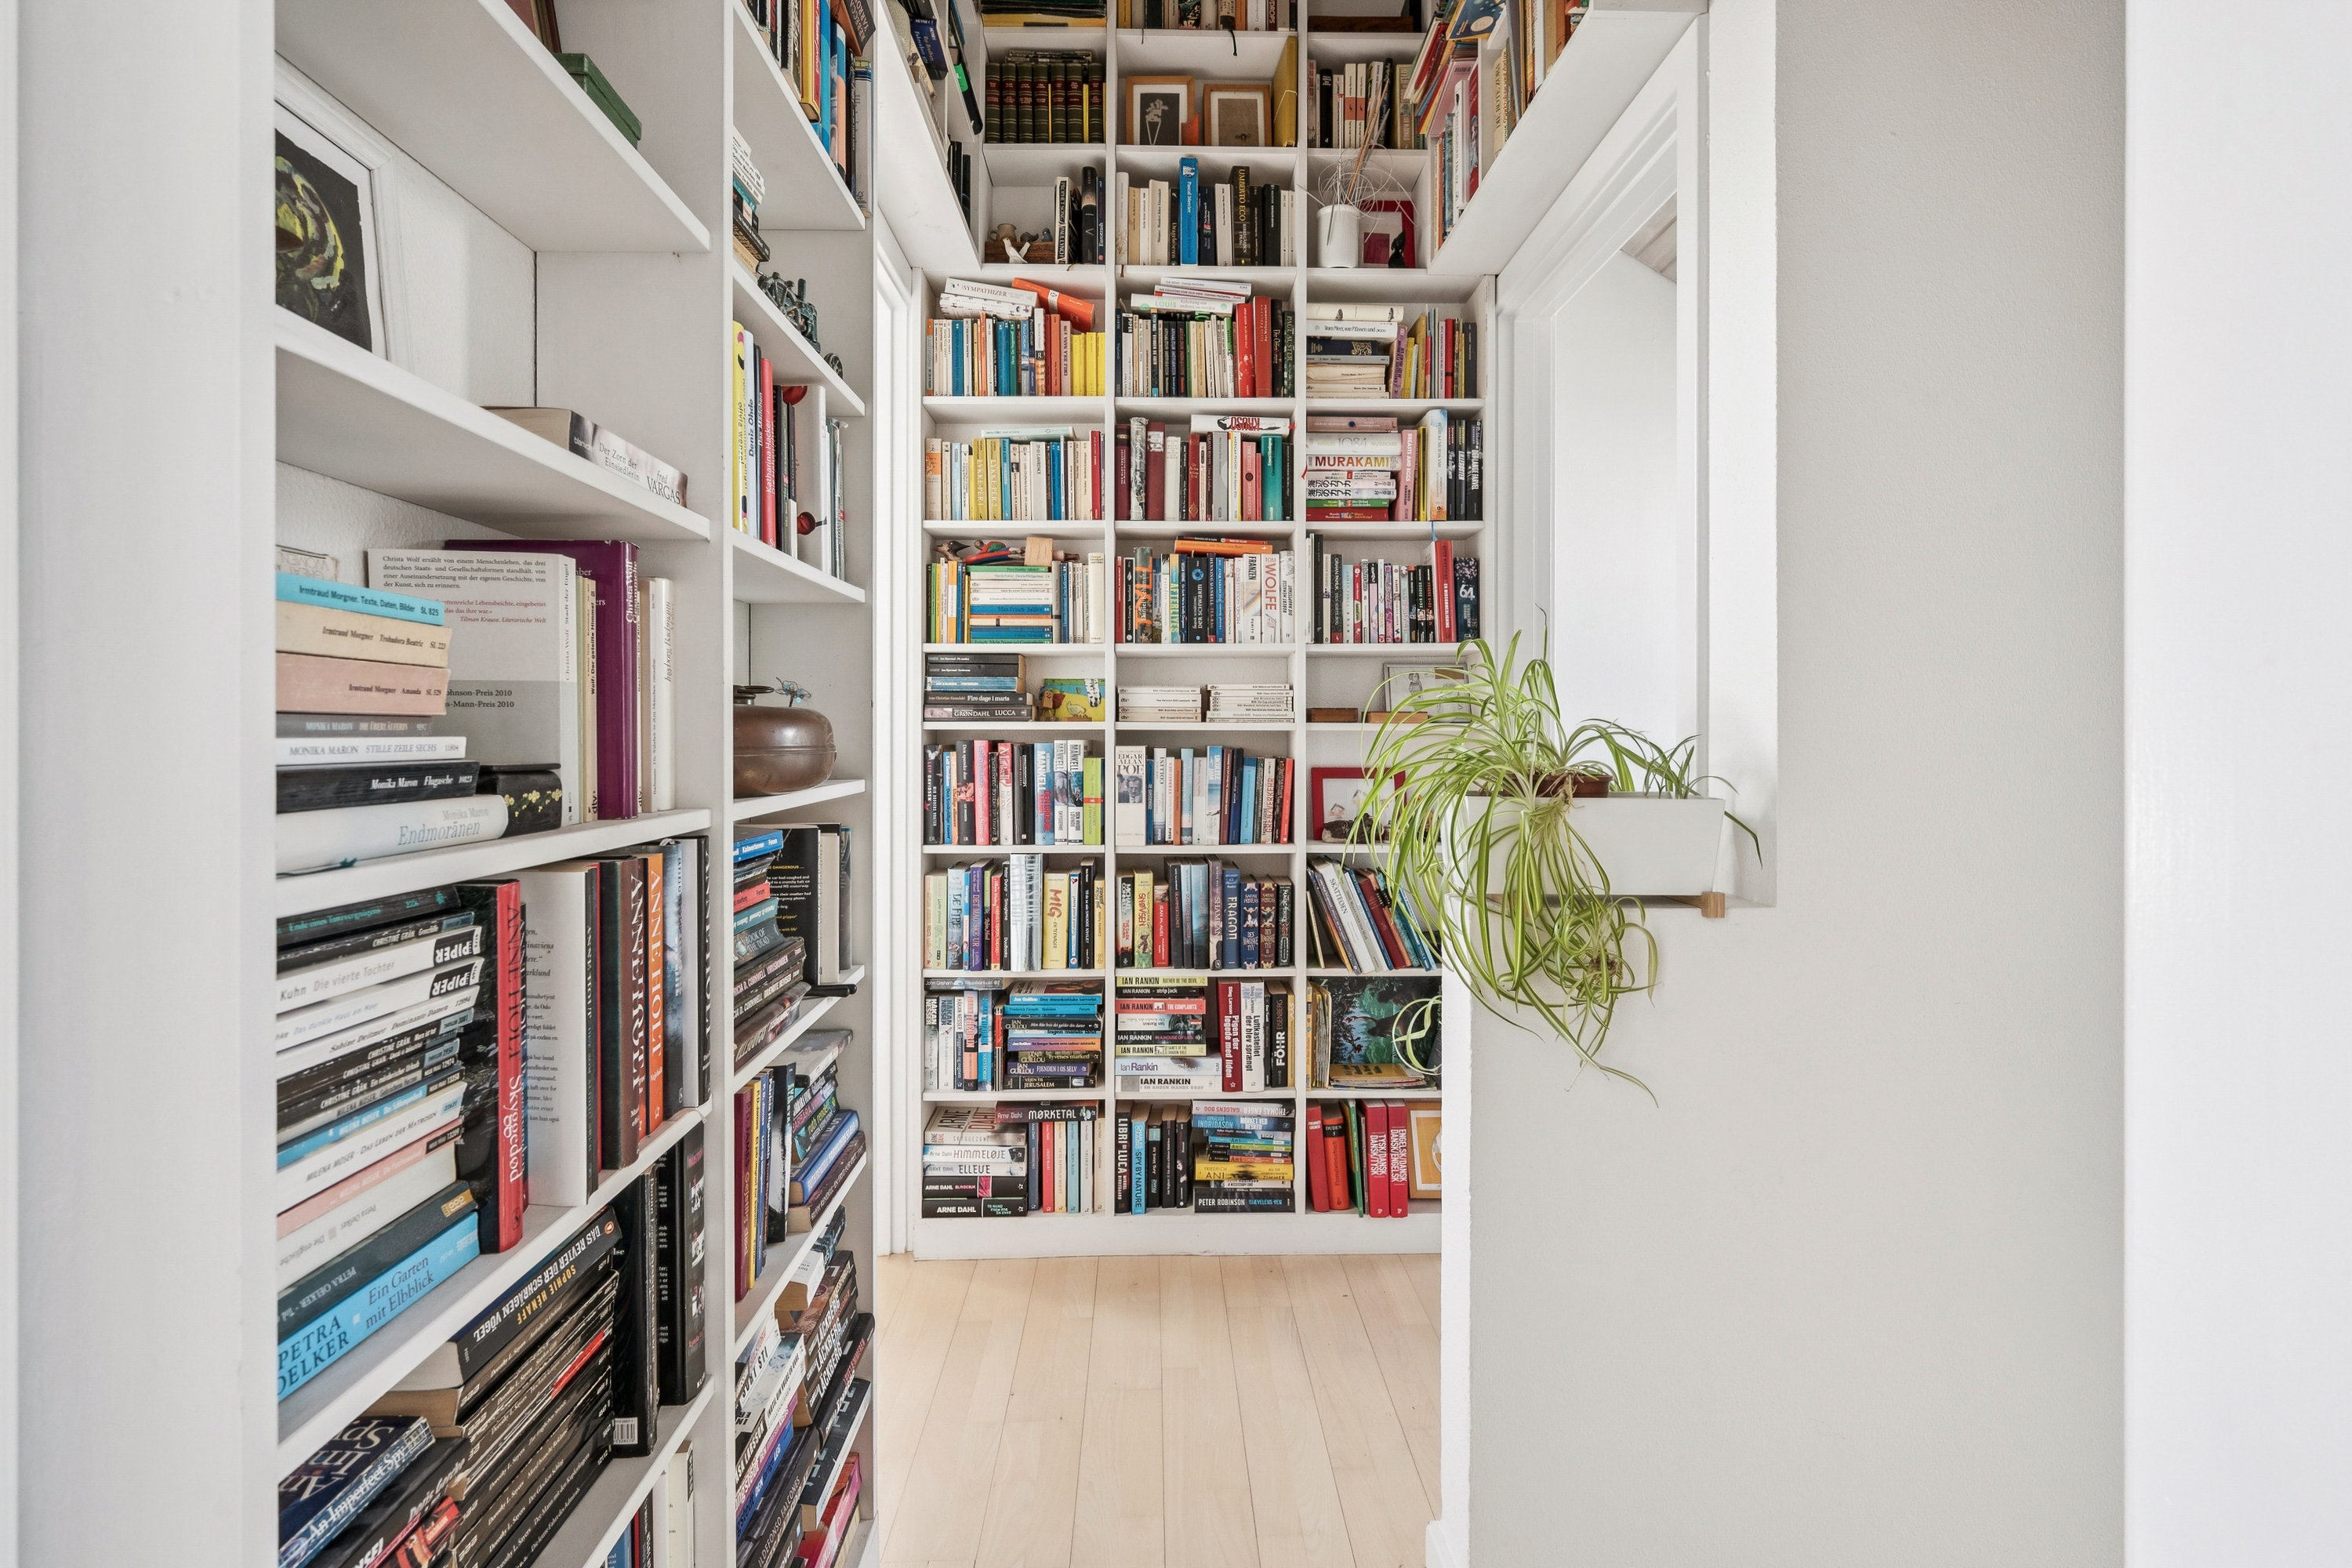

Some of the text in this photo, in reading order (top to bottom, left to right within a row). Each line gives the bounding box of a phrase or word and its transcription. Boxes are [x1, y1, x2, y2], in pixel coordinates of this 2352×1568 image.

[962, 285, 1007, 297] SYMPATHIZER
[599, 442, 637, 470] Der Zorn der
[605, 457, 640, 481] Einsiedlerin
[1315, 456, 1389, 466] MURAKAMI
[647, 476, 681, 504] VARGAS
[656, 470, 667, 484] fred
[1248, 557, 1257, 580] FRANZEN
[299, 585, 329, 598] Irmtraud
[399, 602, 416, 612] Bilder
[1265, 564, 1276, 610] WOLFE
[365, 745, 392, 754] STILLE
[394, 745, 414, 753] ZEILE
[370, 775, 453, 790] Monika Maron Flugasche
[442, 808, 489, 822] Monika Maron
[1051, 889, 1062, 918] MIG
[435, 939, 470, 964] PIPER
[651, 869, 661, 1056] ANNE HOLT
[280, 985, 307, 1001] Kuhn
[432, 971, 470, 996] PIPER
[1274, 1032, 1285, 1066] FÖHR
[1029, 1109, 1076, 1120] MØRKETAL
[1118, 1118, 1127, 1173] LIBRI LUCA
[1370, 1135, 1378, 1175] DANSK/TYSK
[1378, 1134, 1387, 1175] TYSK/DANSK
[1390, 1129, 1399, 1182] DANSK/ENGELSK
[1399, 1129, 1407, 1182] ENGELSK/DANSK
[959, 1164, 991, 1174] ELLEVE
[1135, 1167, 1142, 1175] BY
[368, 1257, 430, 1306] Ein Garten
[474, 1225, 601, 1342] DAS REVIER DER SCHRÄGEN VÖGEL
[517, 1264, 577, 1326] SOPHIE HÉNAFF
[365, 1270, 434, 1330] mit Elbblick
[278, 1316, 342, 1370] PETRA
[308, 1523, 329, 1544] An
[326, 1474, 383, 1522] Imperfect
